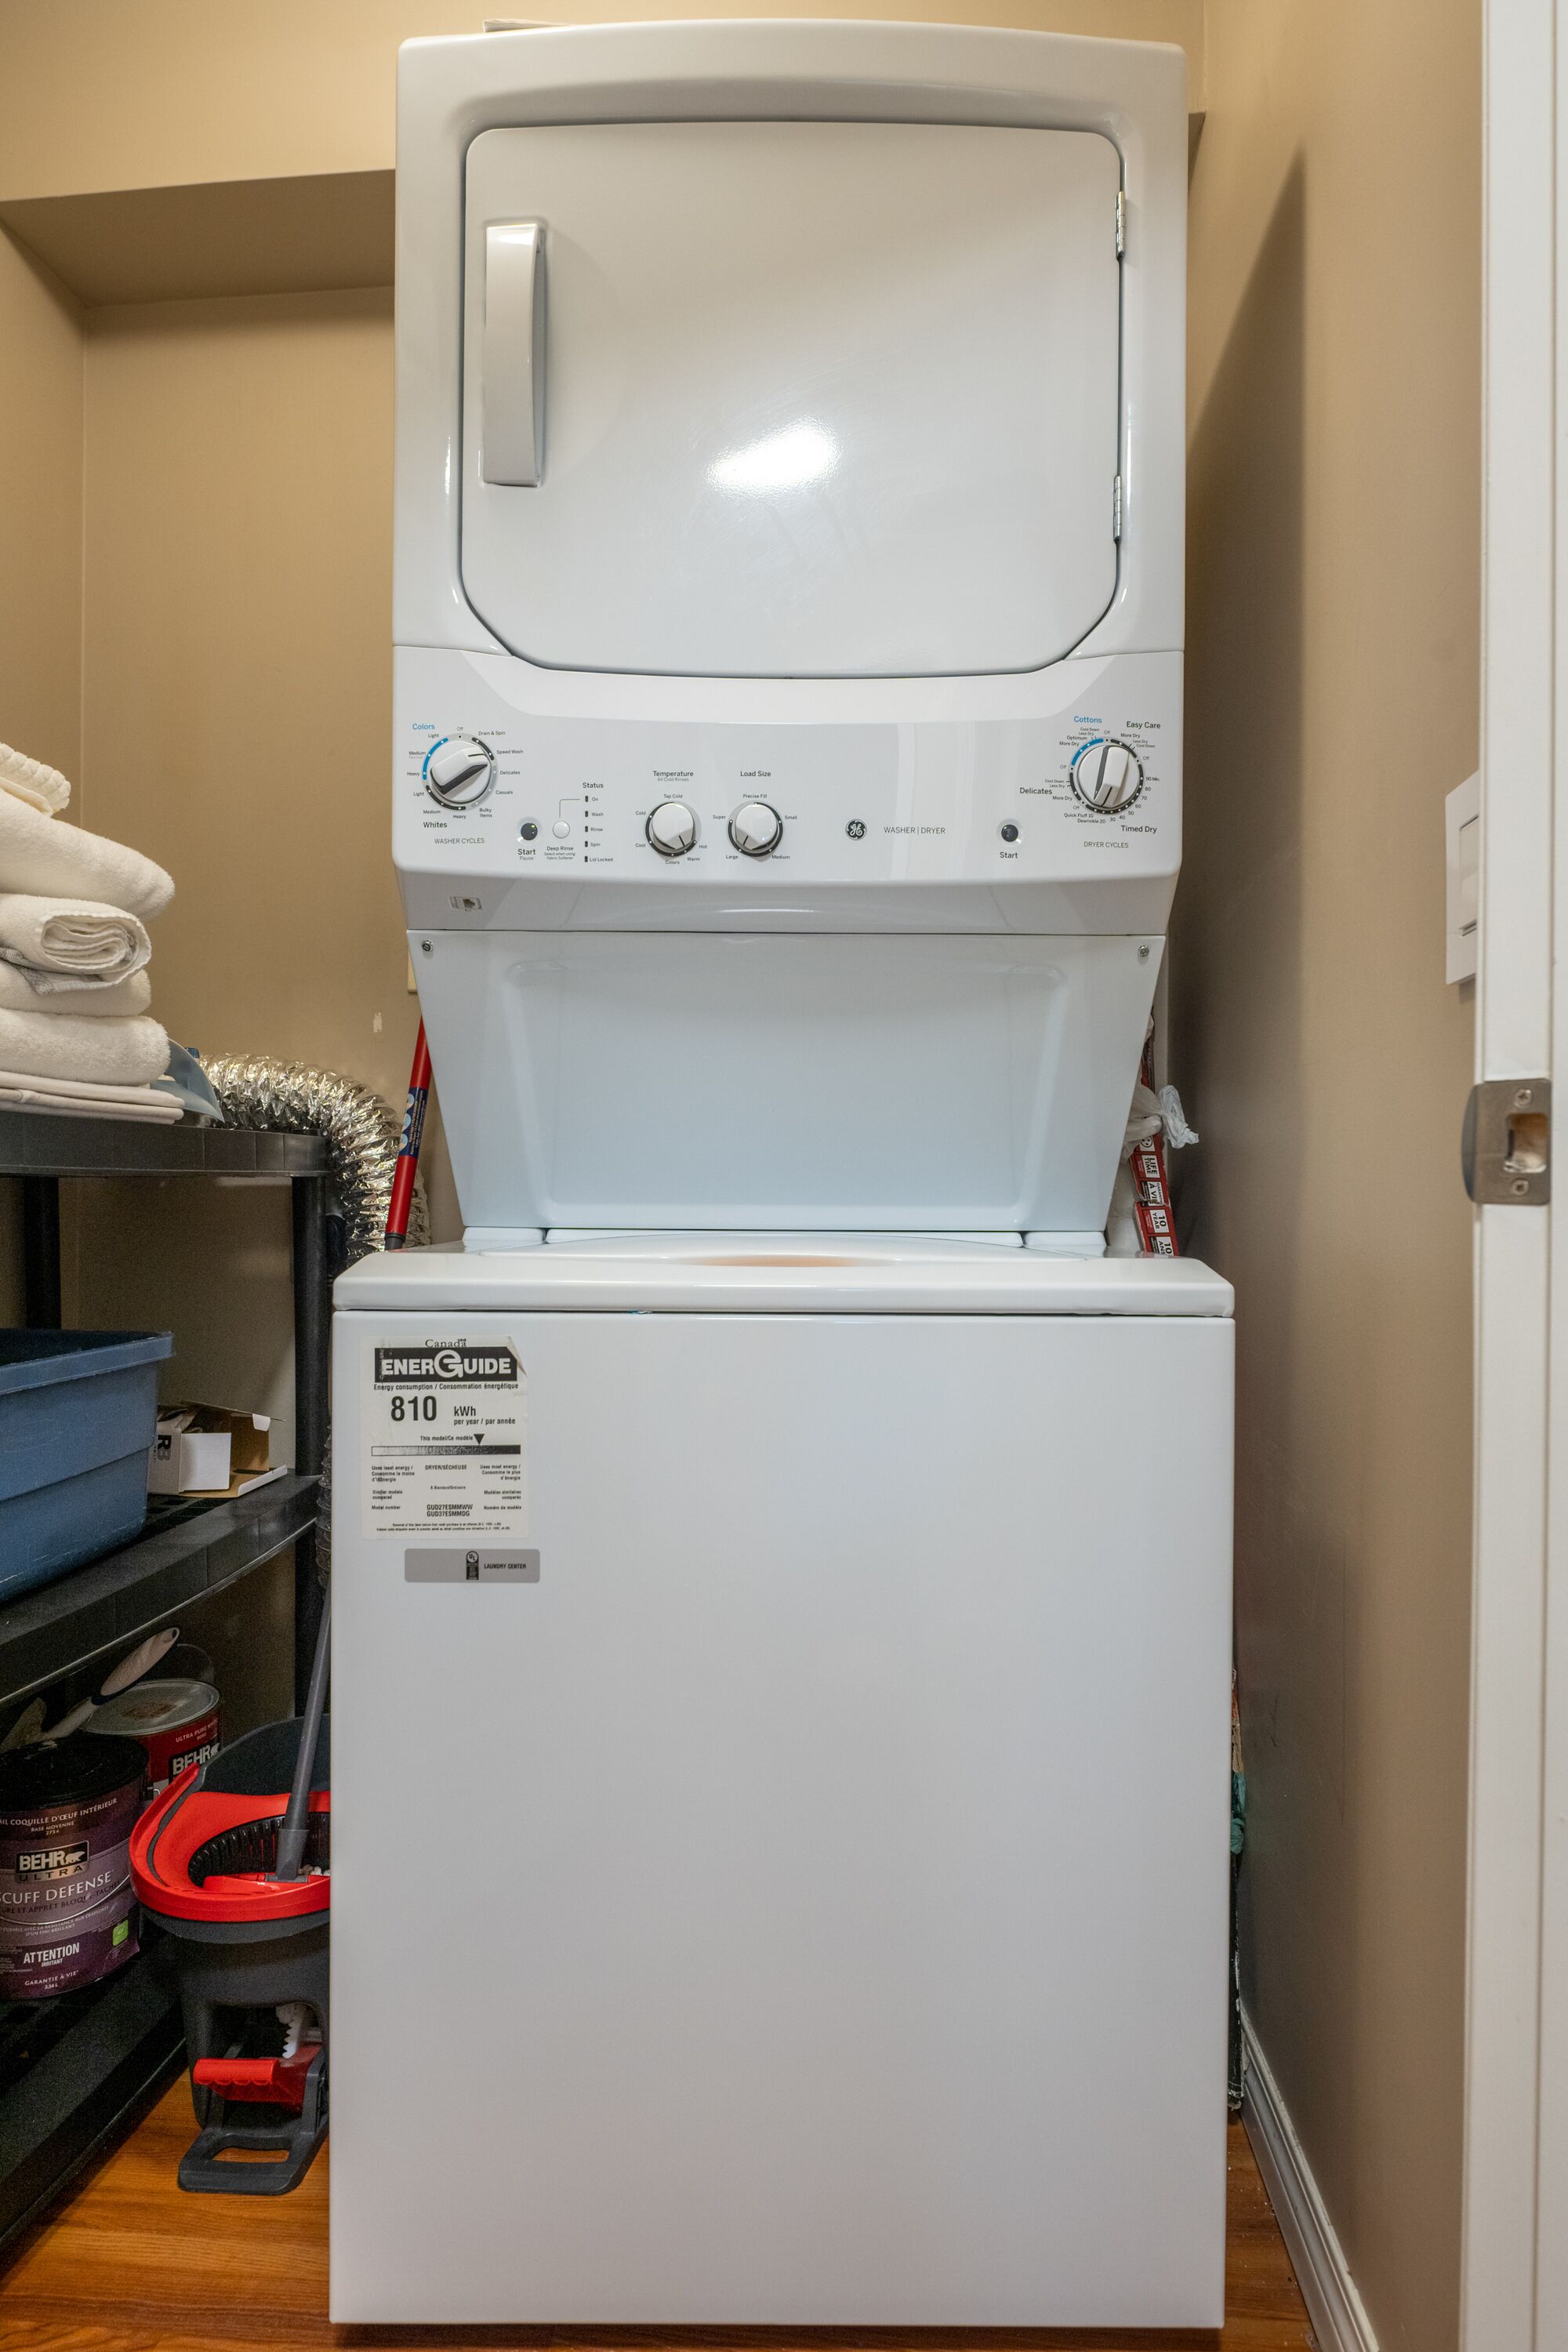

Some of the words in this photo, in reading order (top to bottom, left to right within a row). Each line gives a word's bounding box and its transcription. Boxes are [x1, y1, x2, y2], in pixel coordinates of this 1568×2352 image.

[1159, 1215, 1167, 1226] 10
[1164, 1243, 1172, 1254] 10
[425, 1338, 466, 1348] Canada
[382, 1349, 511, 1378] ENERGUIDE
[391, 1396, 437, 1421] 810
[454, 1406, 476, 1416] kWh
[176, 1733, 193, 1742] ULTRA
[173, 1744, 210, 1775] BEHR
[10, 1817, 49, 1827] COQUILLE
[80, 1798, 118, 1816] INTÉRIEUR
[45, 1820, 74, 1830] MOYENNE
[19, 1850, 66, 1871] BEHR
[19, 1865, 83, 1882] ULTRA
[45, 1871, 111, 1901] DEFENSE
[24, 1943, 80, 1965] ATTENTION
[41, 1958, 63, 1968] IRRITANT
[24, 1976, 58, 1986] GARANTIE
